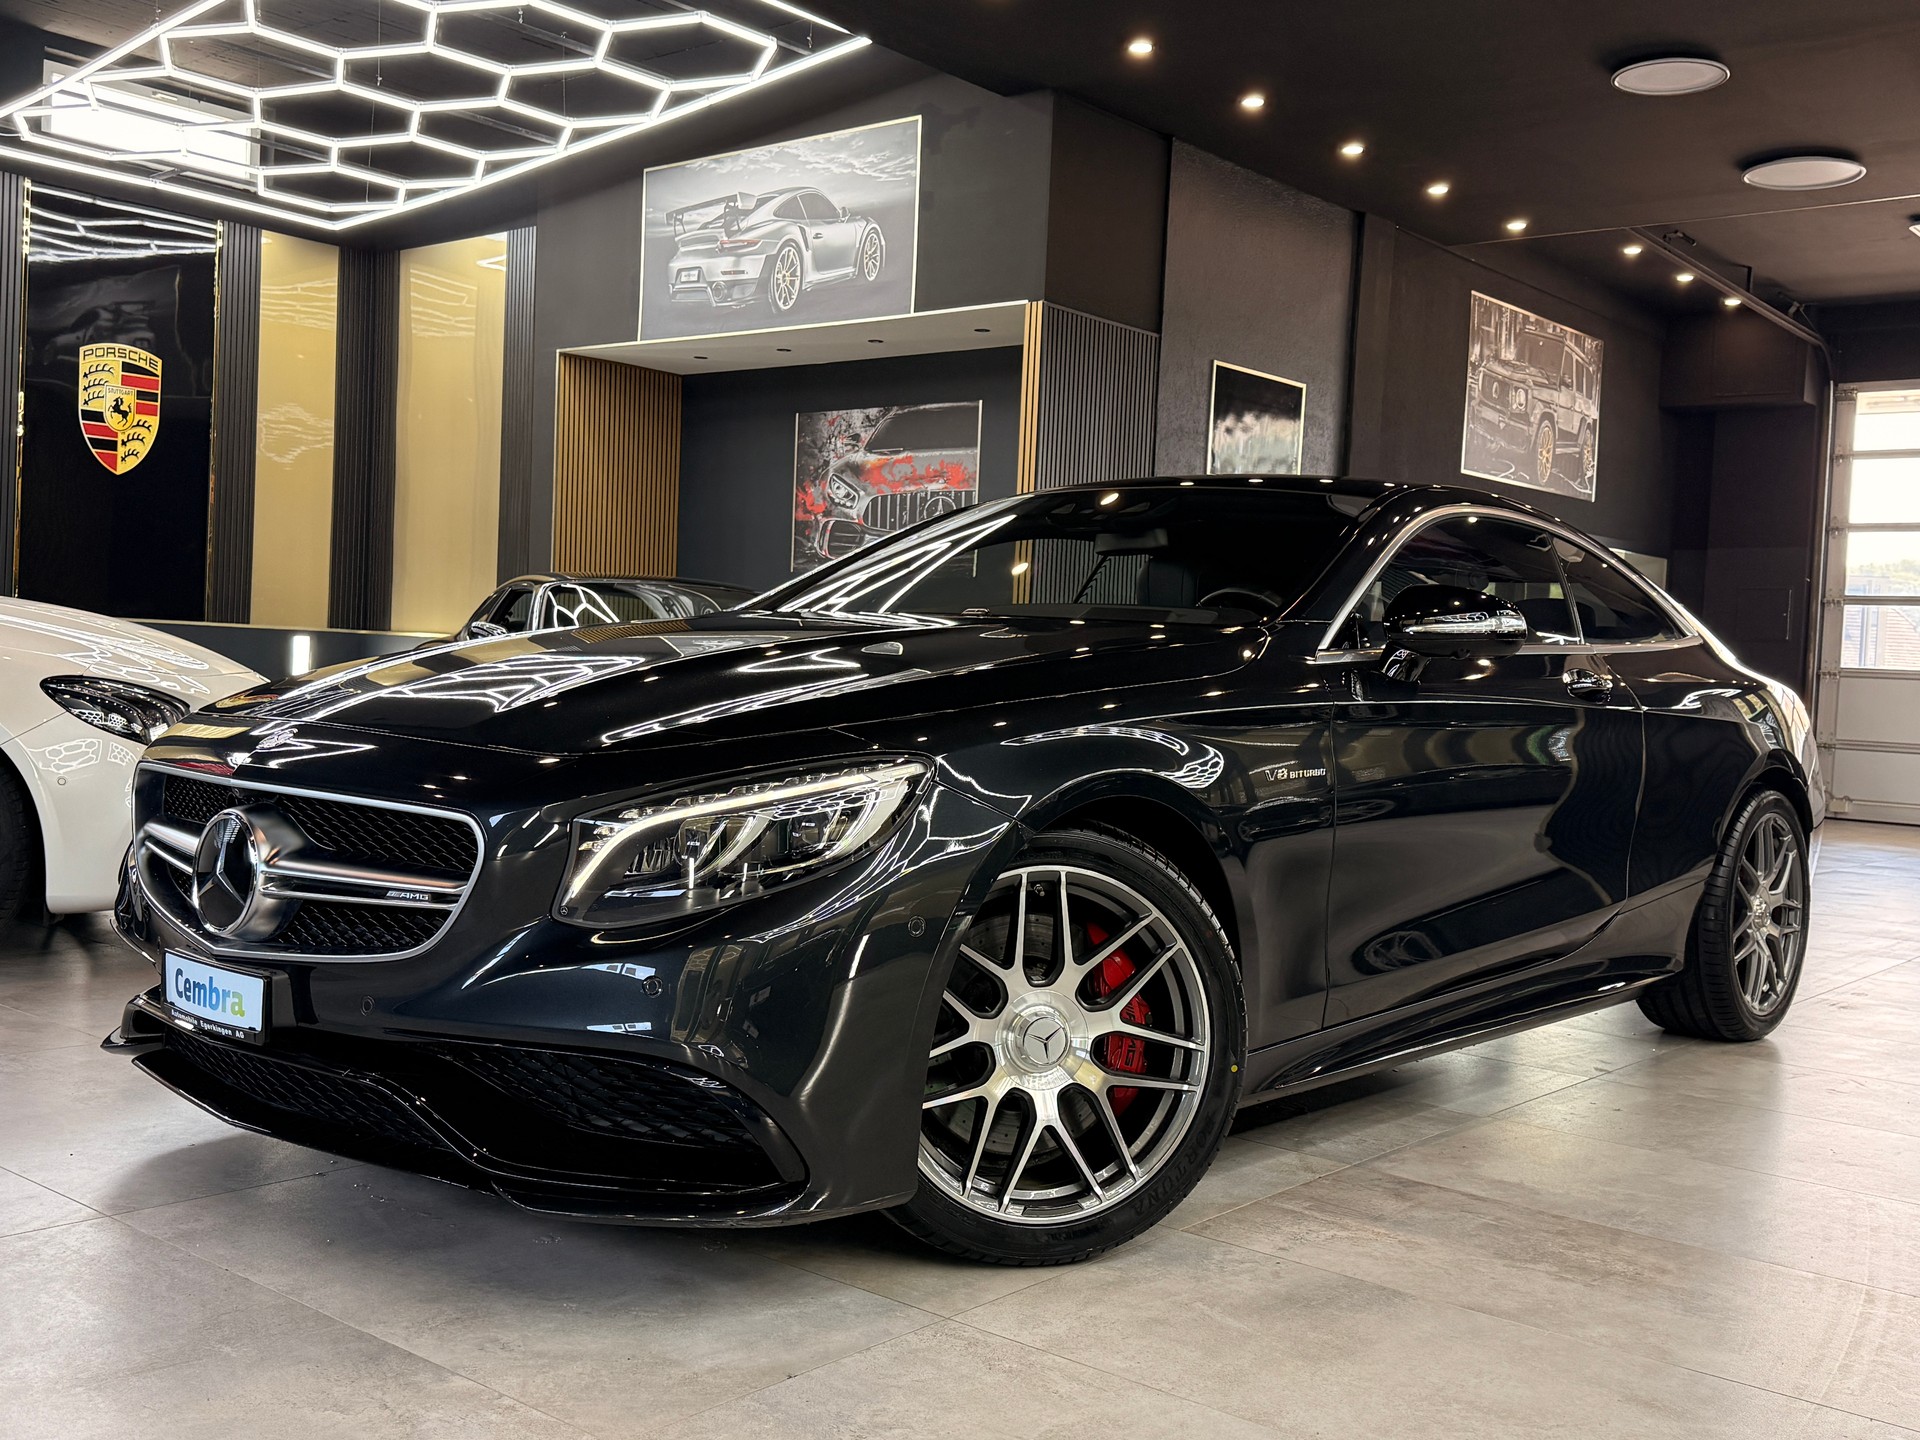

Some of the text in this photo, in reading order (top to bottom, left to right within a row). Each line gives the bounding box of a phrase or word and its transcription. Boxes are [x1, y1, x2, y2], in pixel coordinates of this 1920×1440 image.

[83, 347, 158, 371] PORSCHE
[1264, 768, 1326, 781] V8 BITURBO
[175, 967, 246, 1018] Cembra
[200, 1020, 233, 1036] Egerkingen
[235, 1030, 245, 1039] AG
